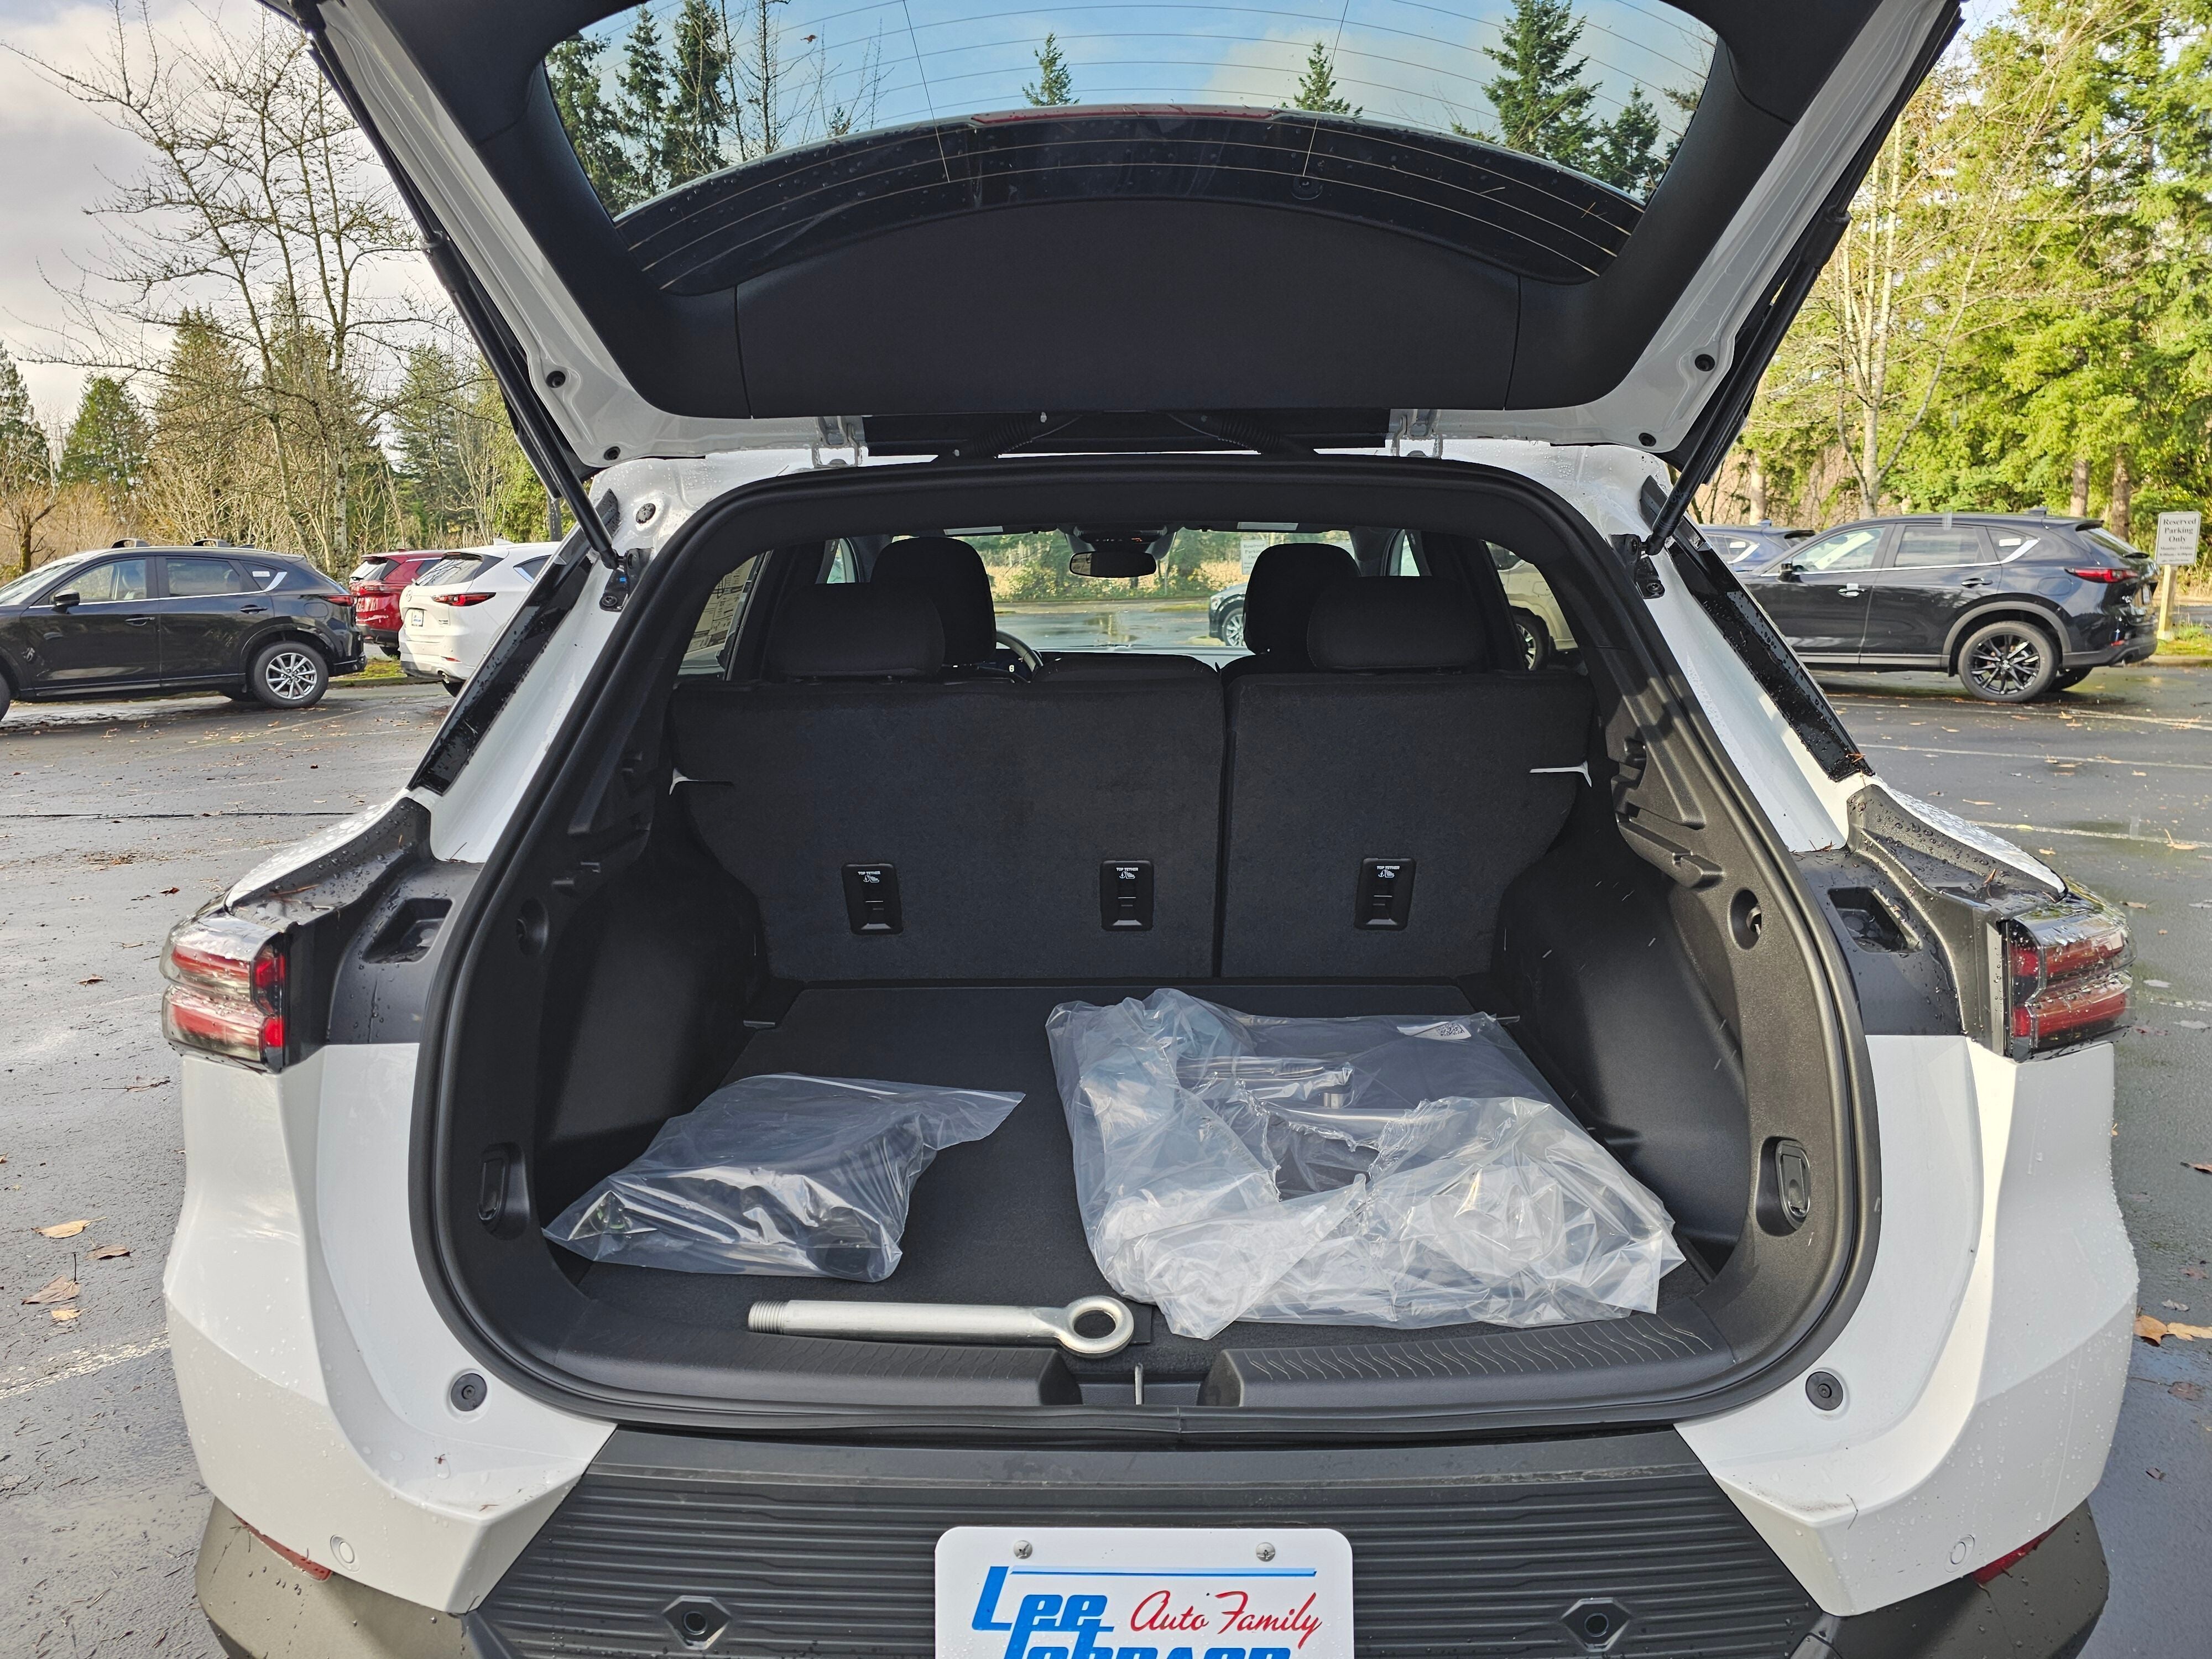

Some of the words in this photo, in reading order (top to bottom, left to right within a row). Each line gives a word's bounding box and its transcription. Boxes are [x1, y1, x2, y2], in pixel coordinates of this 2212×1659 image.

[2169, 536, 2185, 544] Only
[972, 1566, 1115, 1632] Lee
[1130, 1590, 1209, 1631] Auto
[1214, 1590, 1323, 1650] Family
